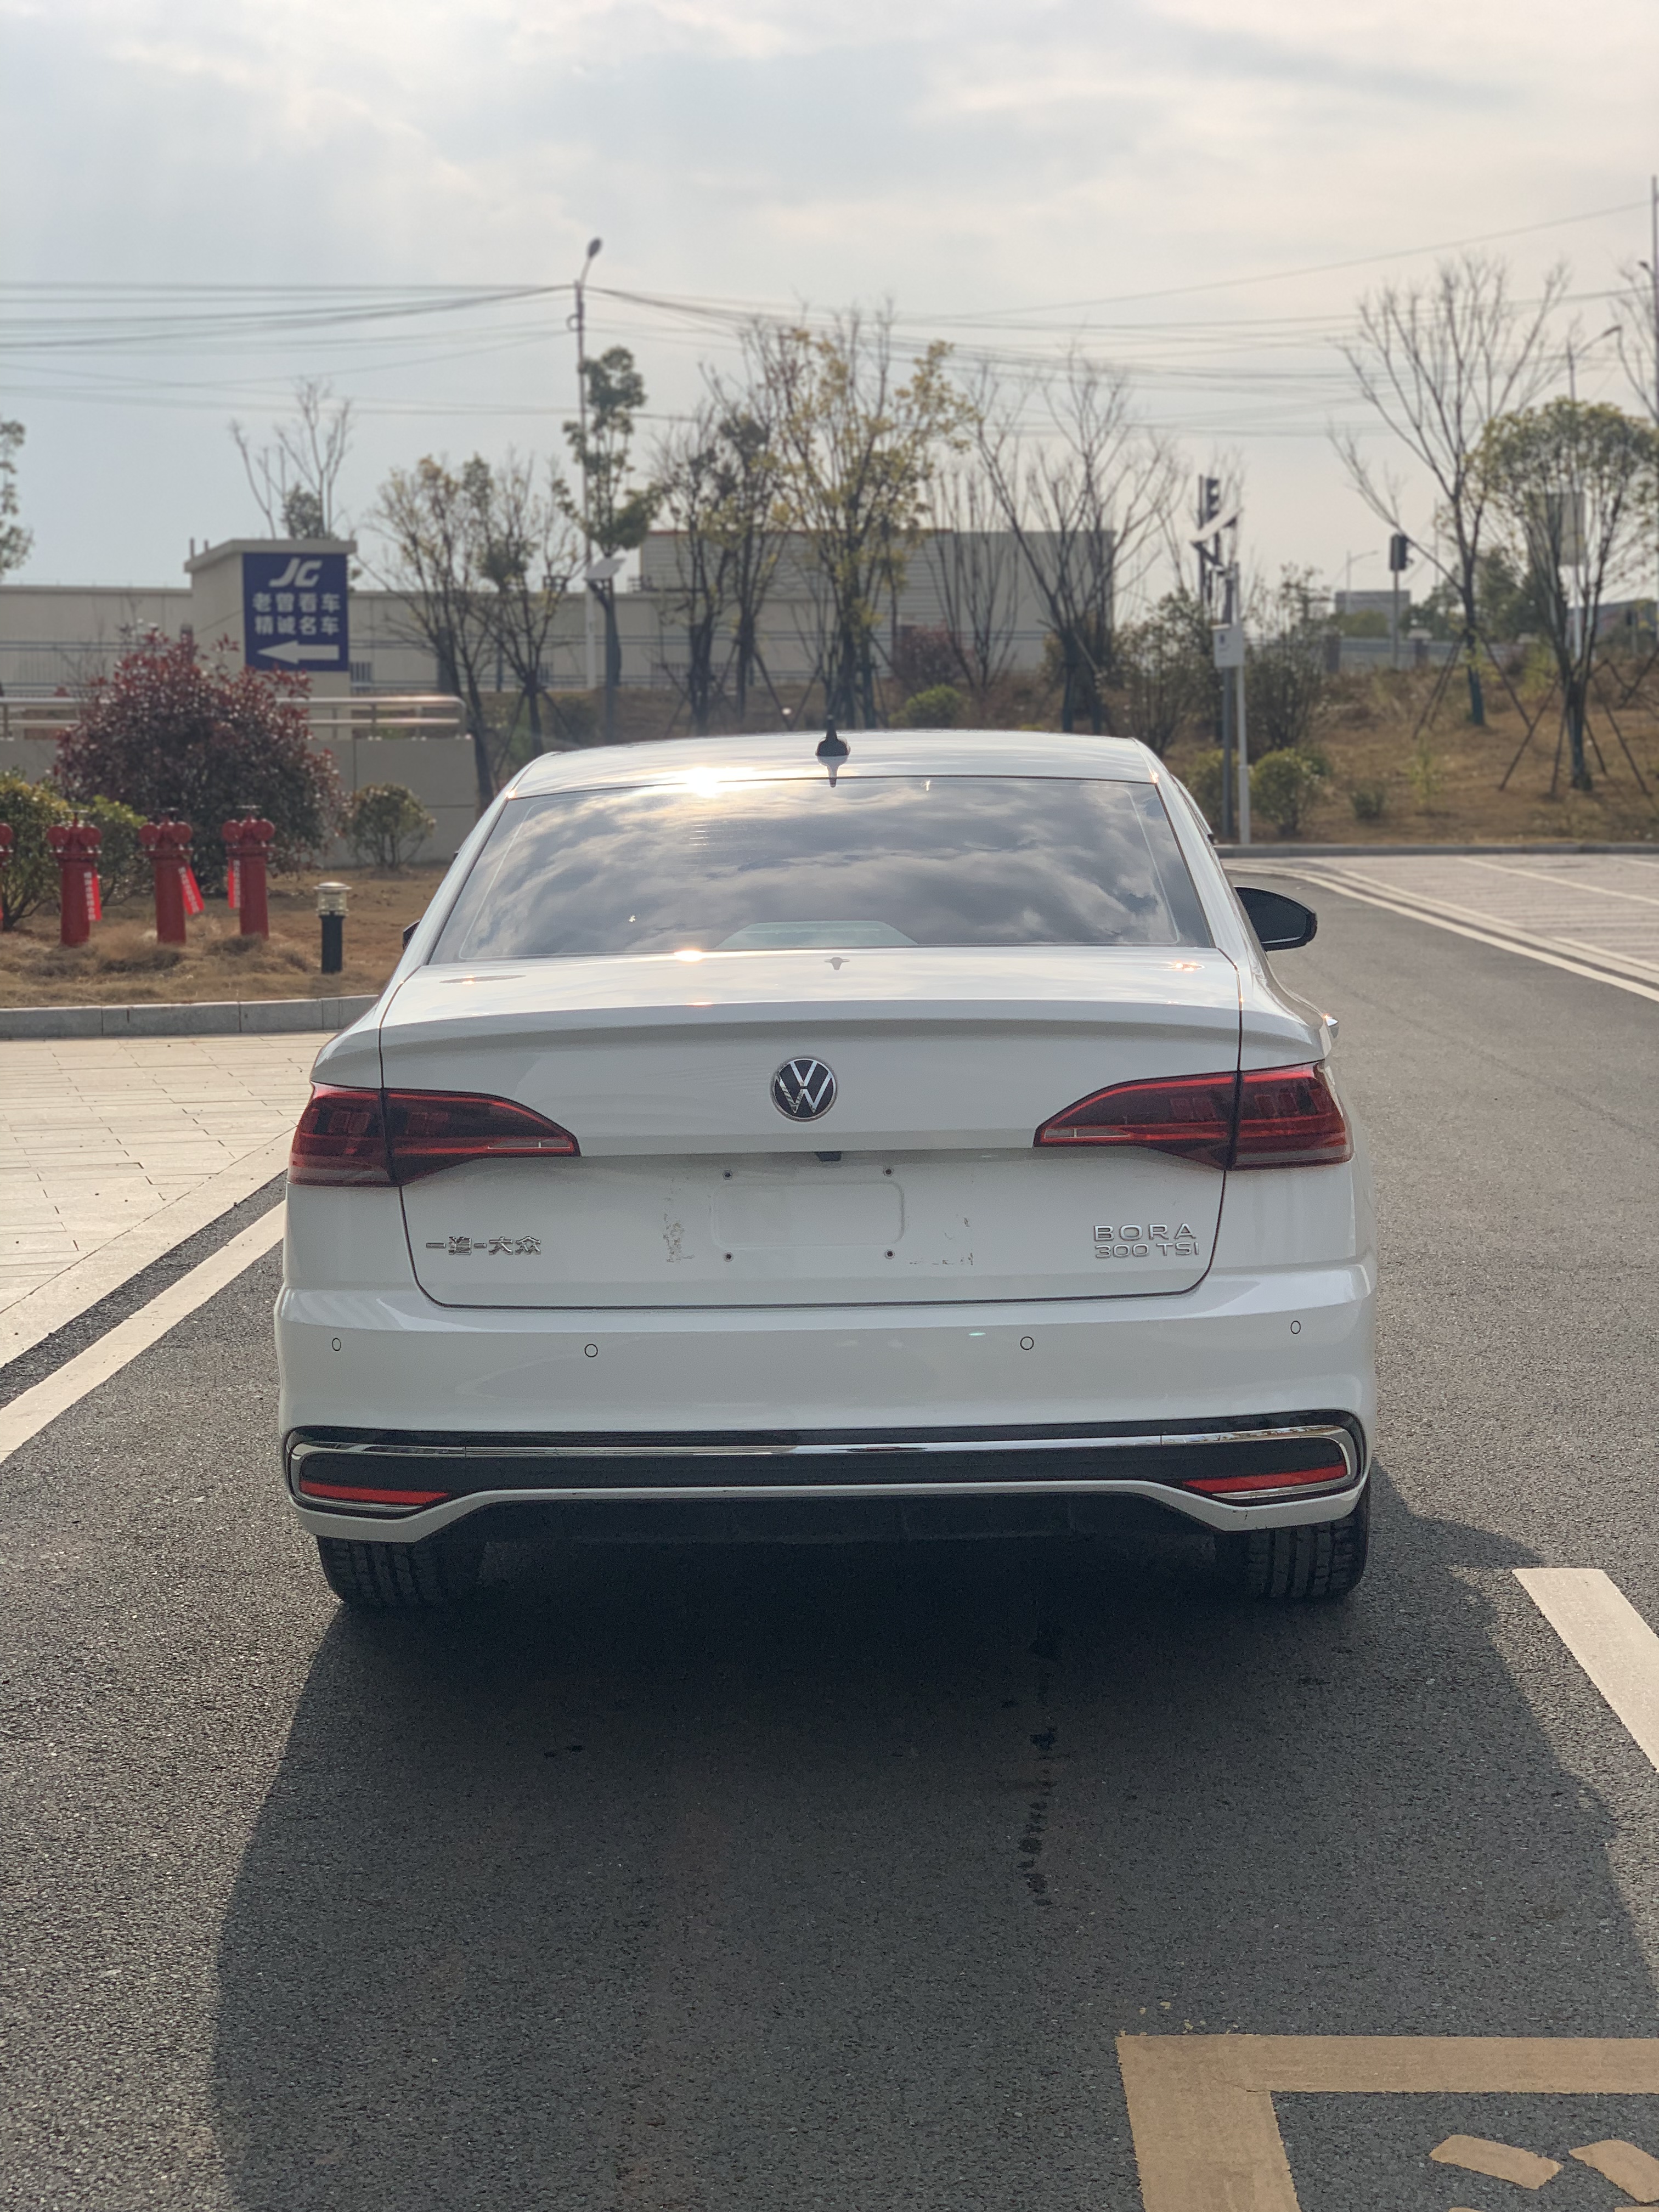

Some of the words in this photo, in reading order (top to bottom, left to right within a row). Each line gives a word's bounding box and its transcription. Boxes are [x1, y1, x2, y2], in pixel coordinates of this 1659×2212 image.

[1093, 1223, 1197, 1242] BORA
[1096, 1244, 1150, 1259] 300
[1156, 1242, 1199, 1256] TSI
